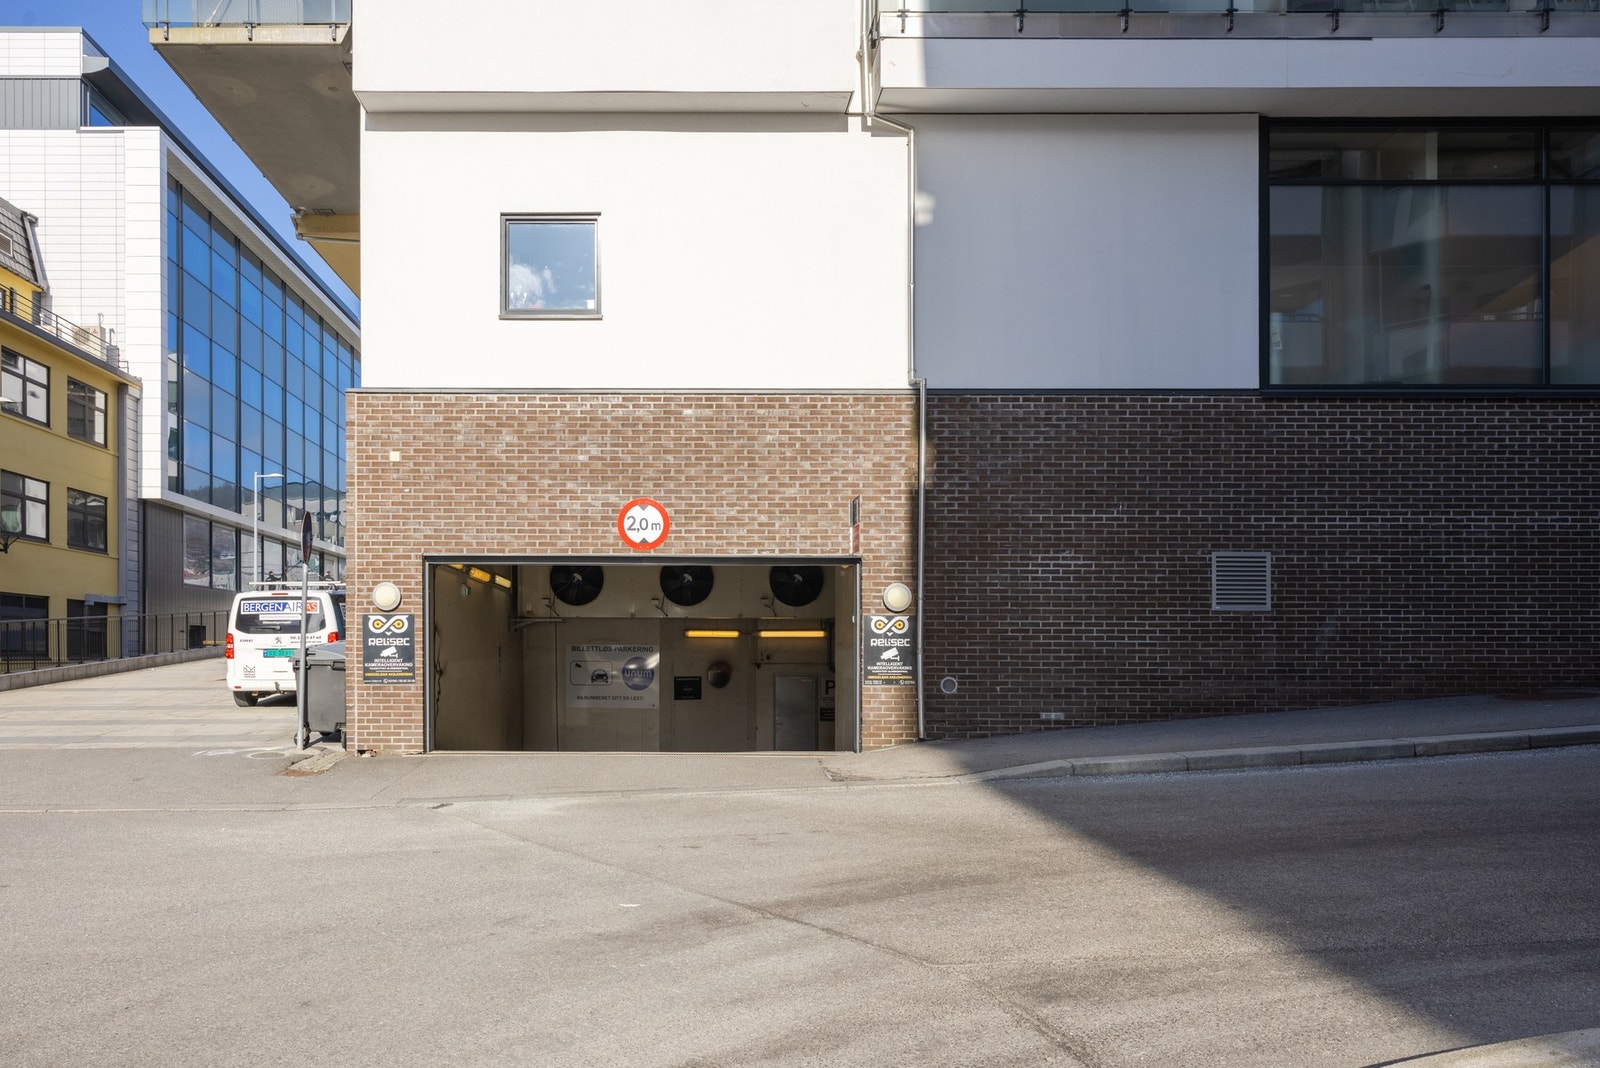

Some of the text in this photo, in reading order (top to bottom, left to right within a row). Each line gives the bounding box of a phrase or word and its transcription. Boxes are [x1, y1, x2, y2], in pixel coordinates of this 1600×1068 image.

[626, 516, 661, 532] 2,0 m
[826, 680, 835, 695] P
